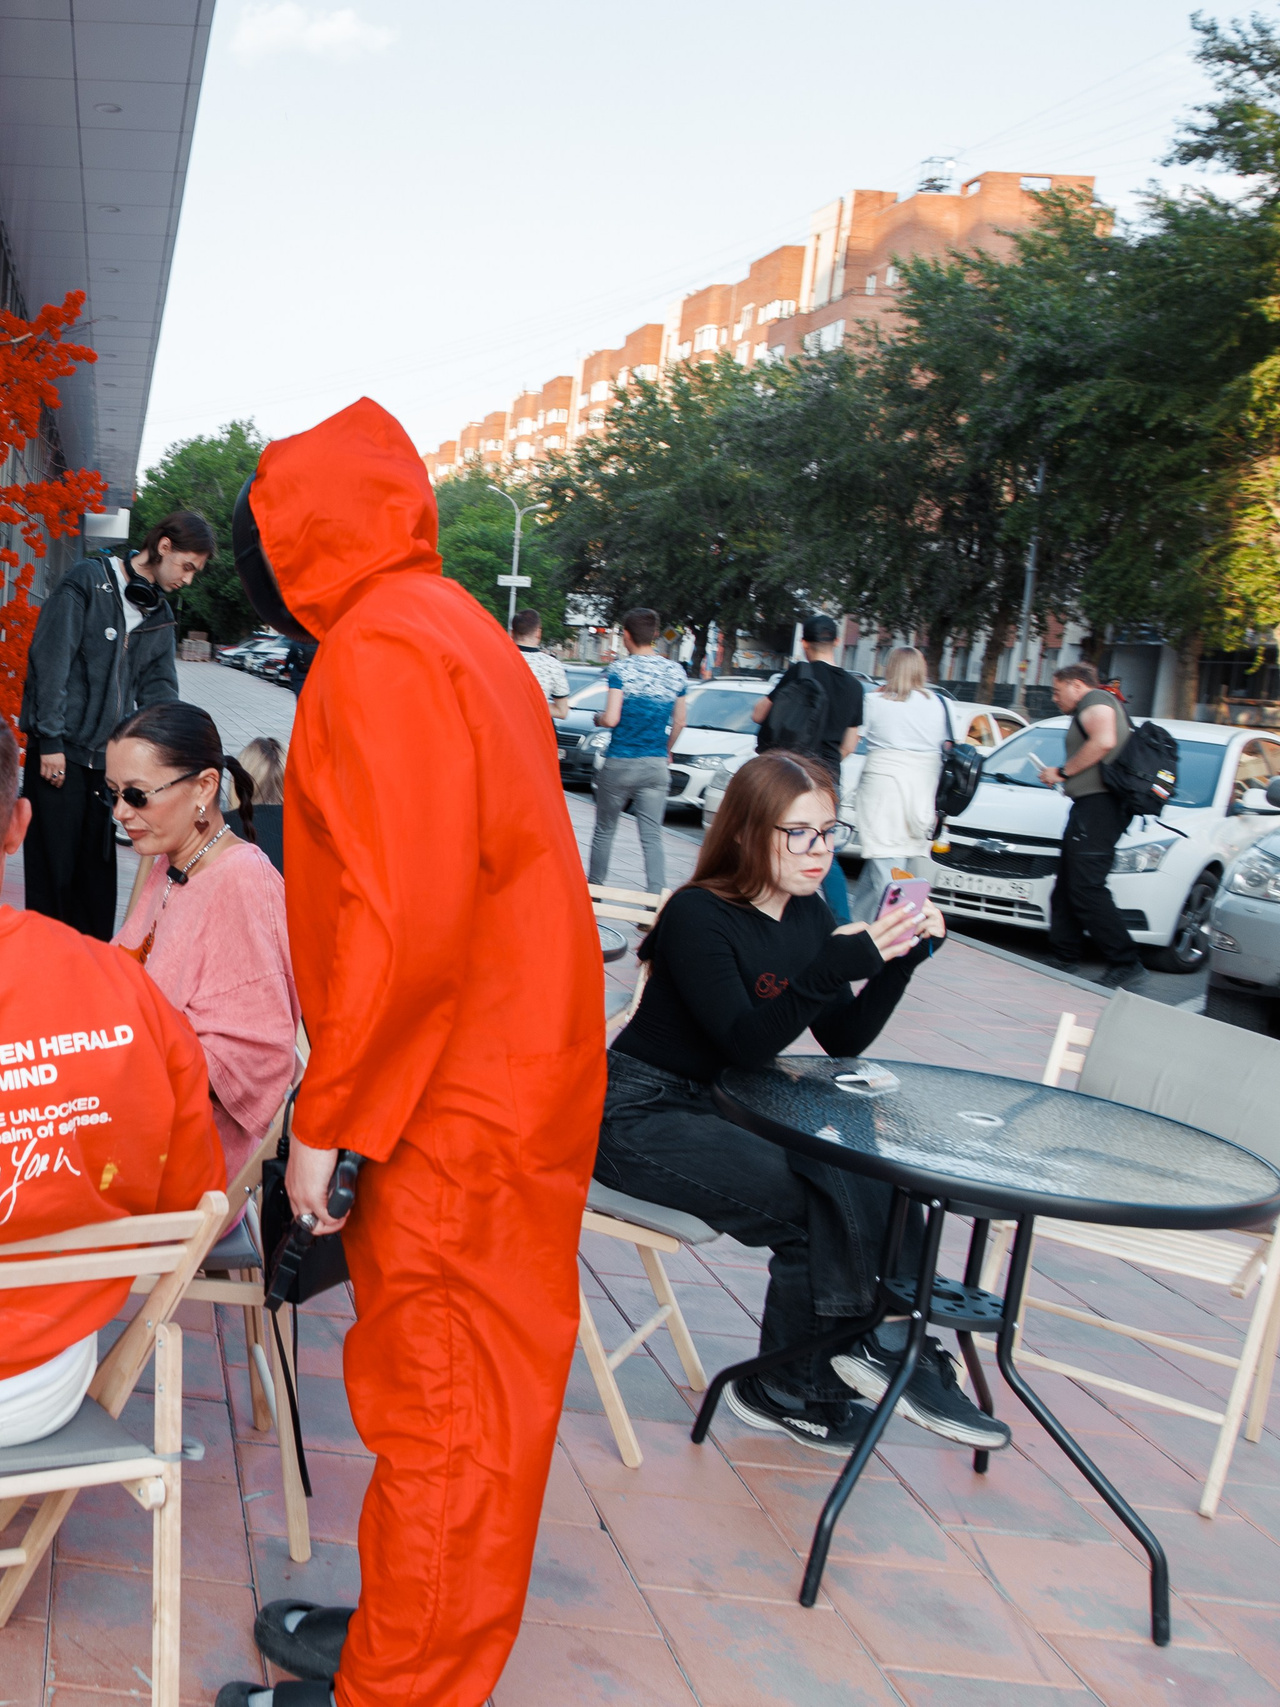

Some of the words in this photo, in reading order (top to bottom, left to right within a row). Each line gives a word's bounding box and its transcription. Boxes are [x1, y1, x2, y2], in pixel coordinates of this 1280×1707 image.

[39, 1025, 134, 1059] HERALD
[9, 1096, 100, 1125] UNLOCKED
[36, 1121, 54, 1139] of
